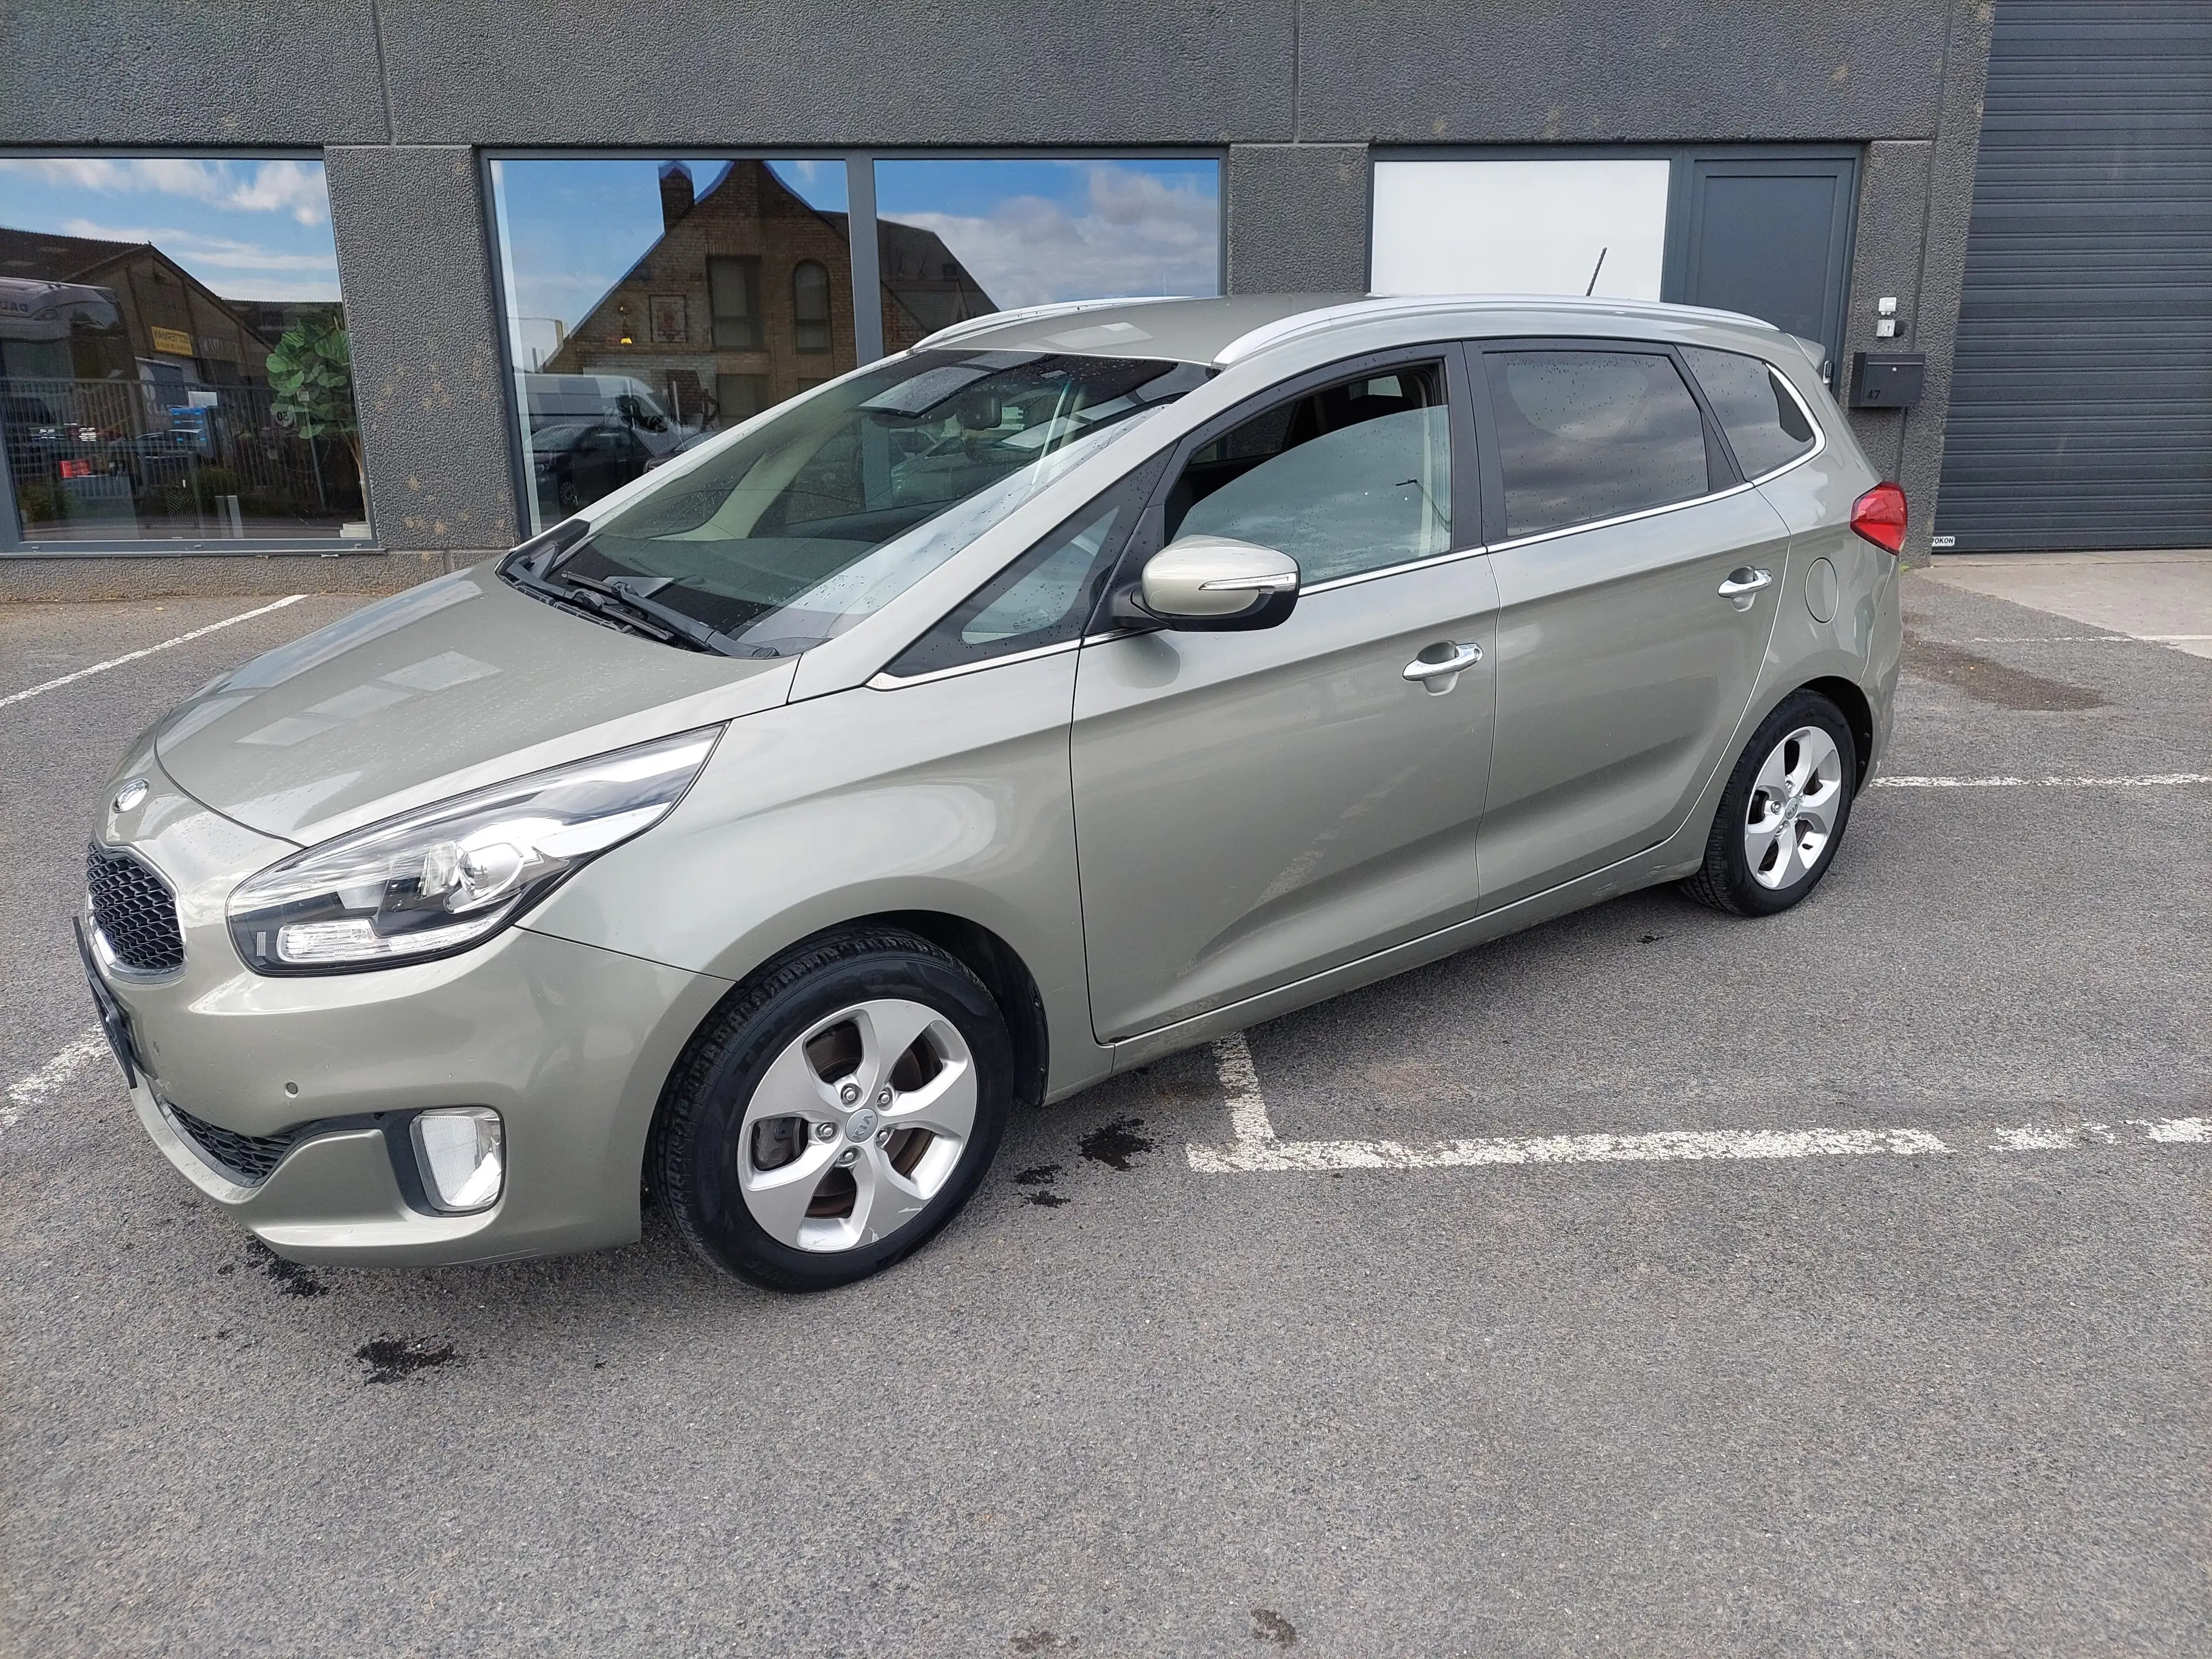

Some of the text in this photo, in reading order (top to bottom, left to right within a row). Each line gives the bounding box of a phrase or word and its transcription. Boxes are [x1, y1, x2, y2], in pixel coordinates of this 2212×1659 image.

[1866, 389, 1881, 400] 47
[1787, 802, 1798, 817] KIA
[851, 1115, 873, 1141] KIA
